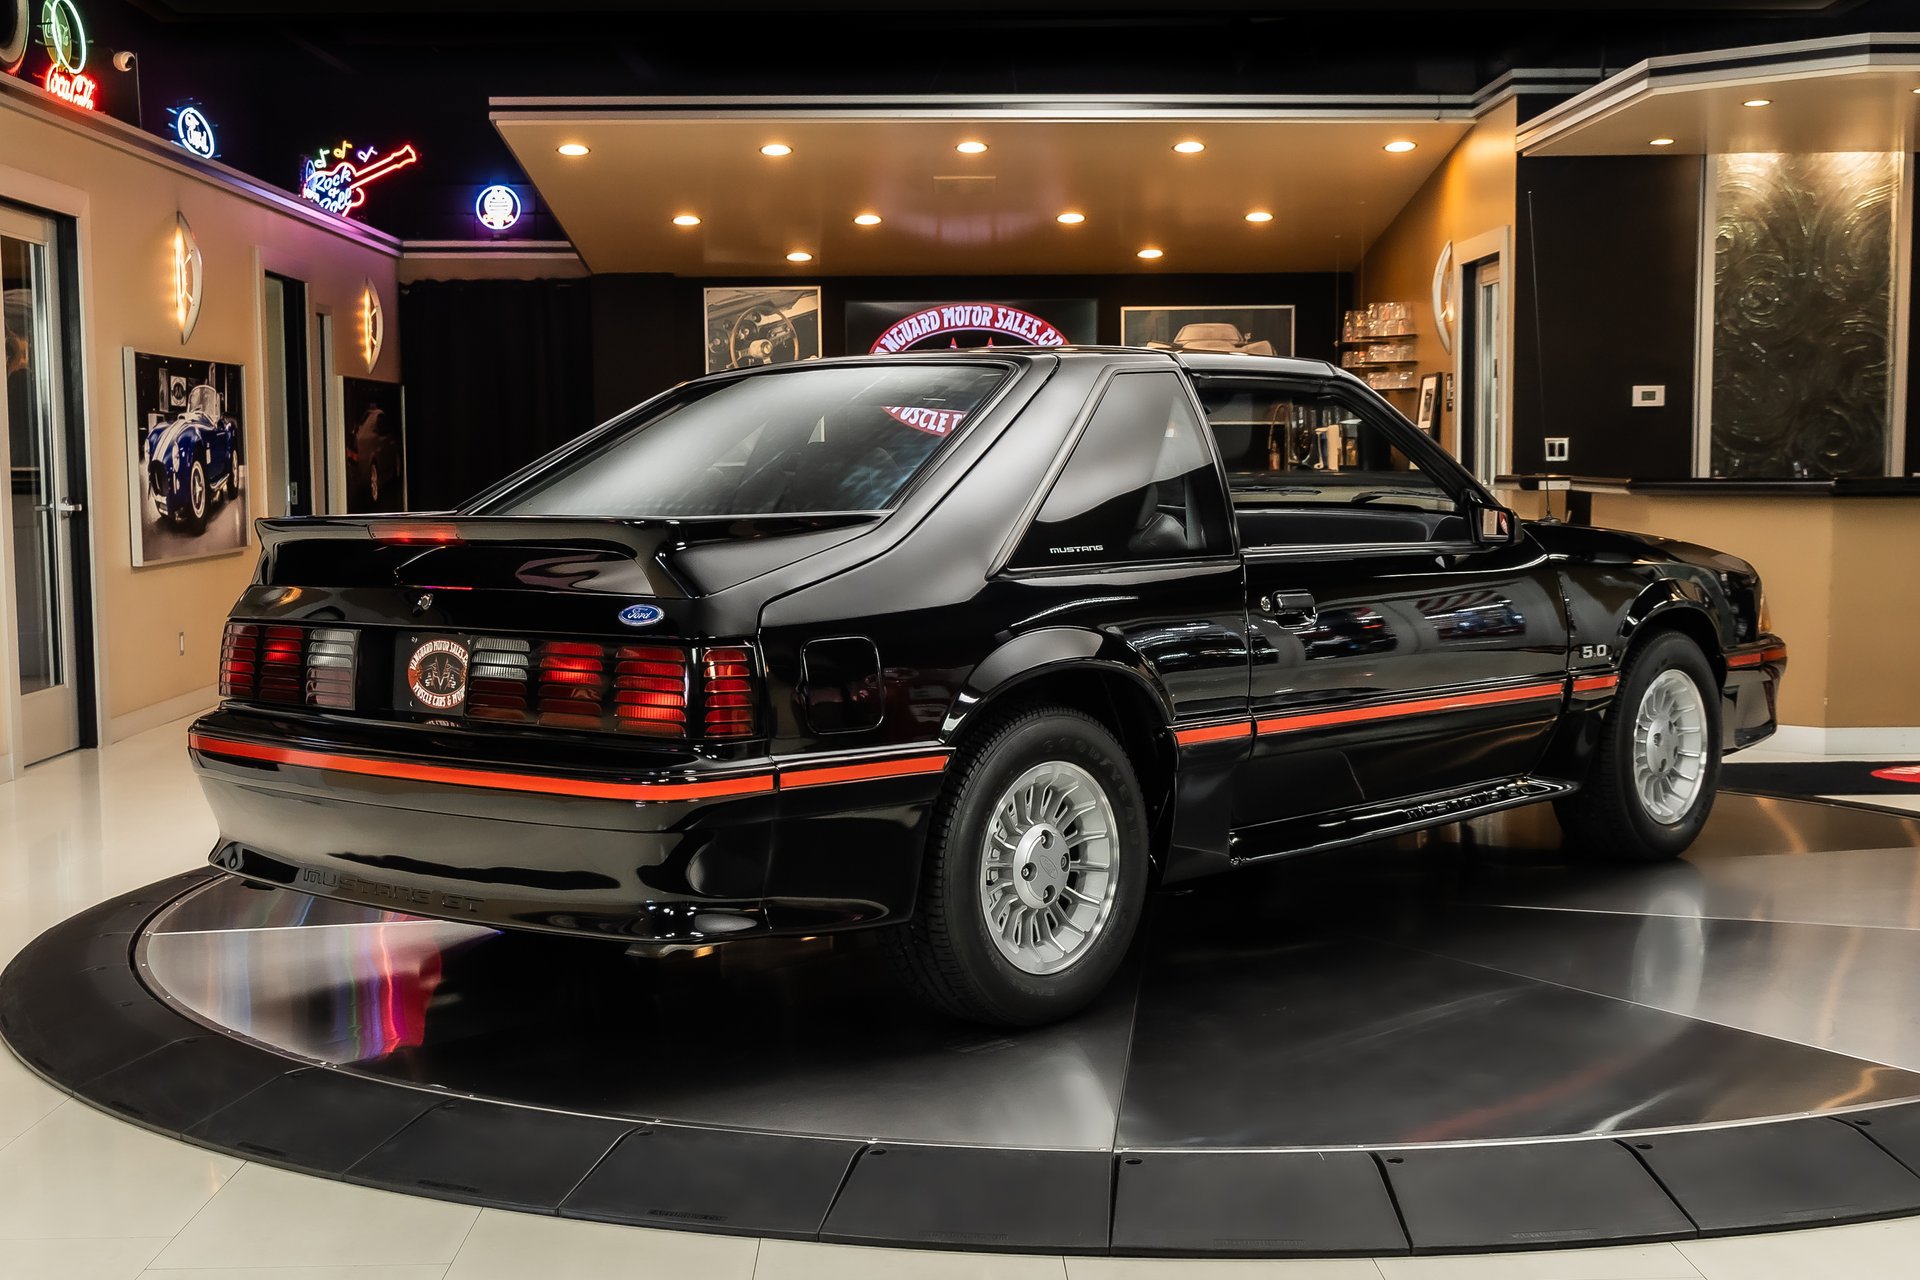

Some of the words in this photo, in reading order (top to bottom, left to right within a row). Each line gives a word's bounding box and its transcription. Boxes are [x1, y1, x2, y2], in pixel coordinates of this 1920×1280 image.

[315, 165, 352, 193] Rock
[874, 310, 940, 352] NGUARD
[942, 305, 994, 328] MOTOR
[994, 307, 1064, 346] SALES.CO
[1049, 544, 1104, 554] MUSTANG
[627, 606, 653, 619] Ford
[433, 640, 450, 651] MOTOR
[1582, 644, 1607, 659] 5.0
[432, 695, 446, 707] CARS
[303, 868, 433, 905] MUSTANG
[441, 893, 485, 912] GT
